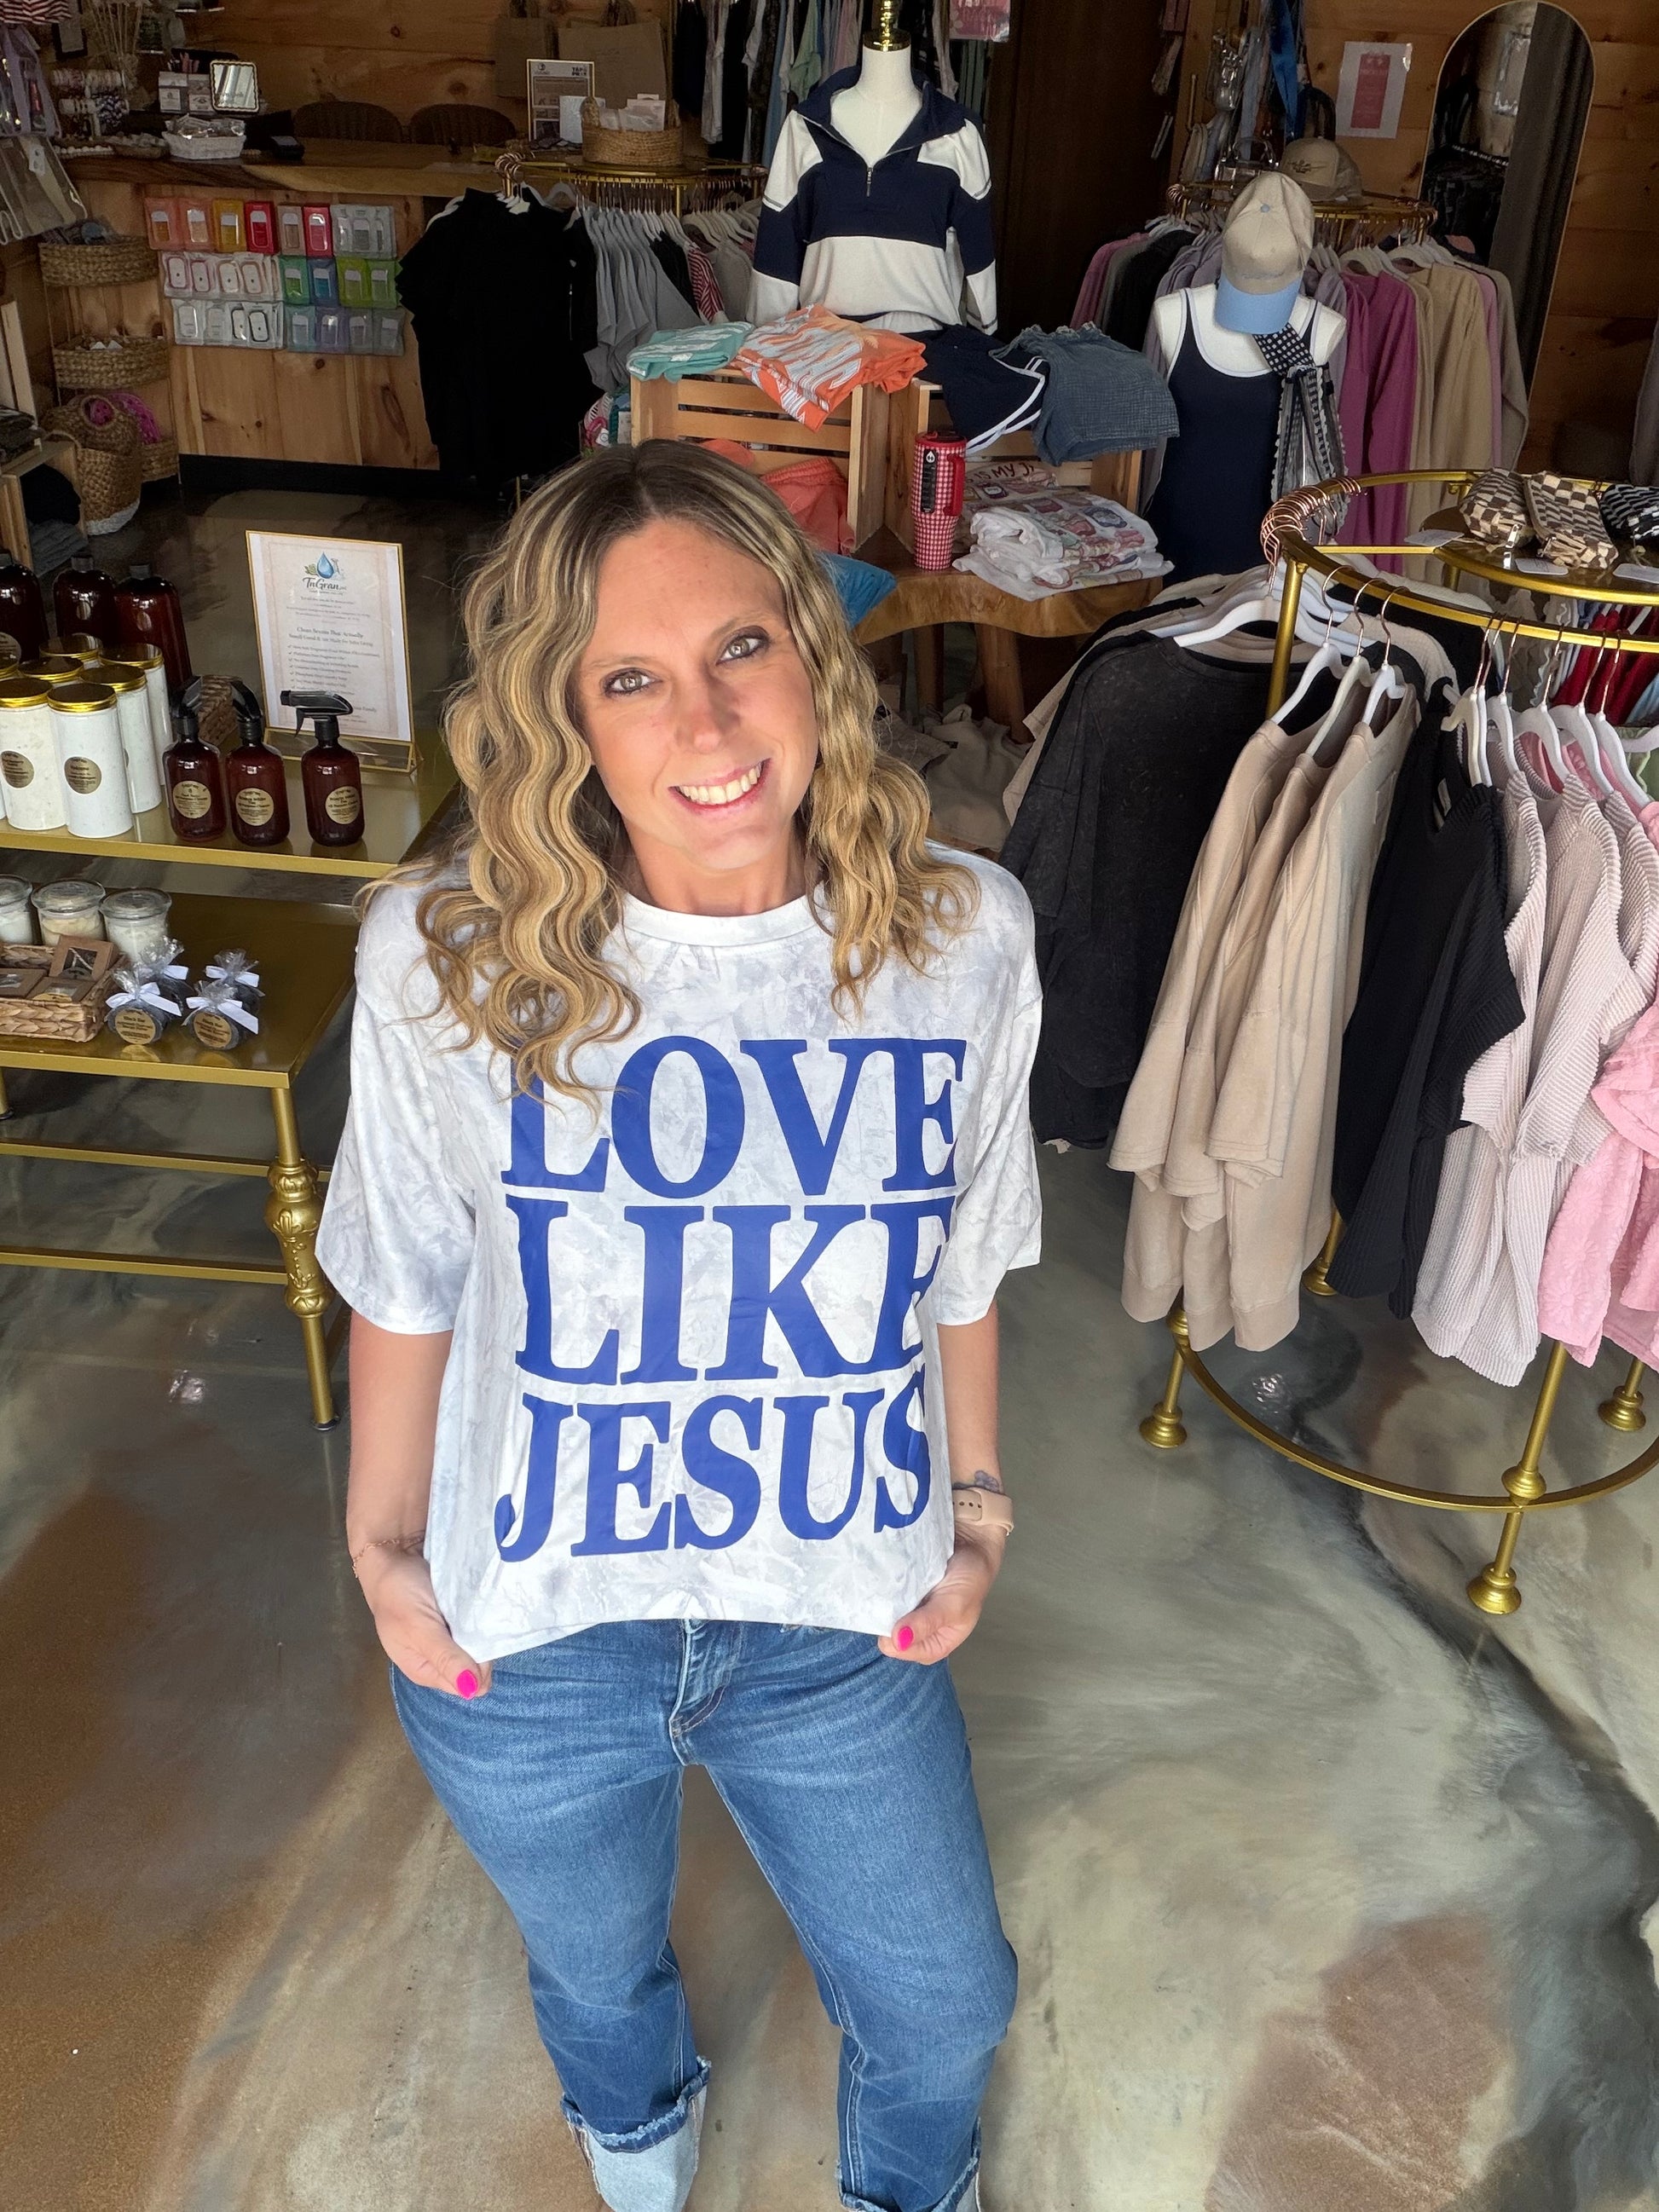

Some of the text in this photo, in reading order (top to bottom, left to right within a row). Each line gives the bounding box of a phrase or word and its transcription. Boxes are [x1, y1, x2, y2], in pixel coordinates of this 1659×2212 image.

[991, 463, 1015, 477] MY
[500, 1035, 968, 1199] LOVE
[506, 1193, 957, 1386] LIKE
[494, 1363, 932, 1563] JESUS
